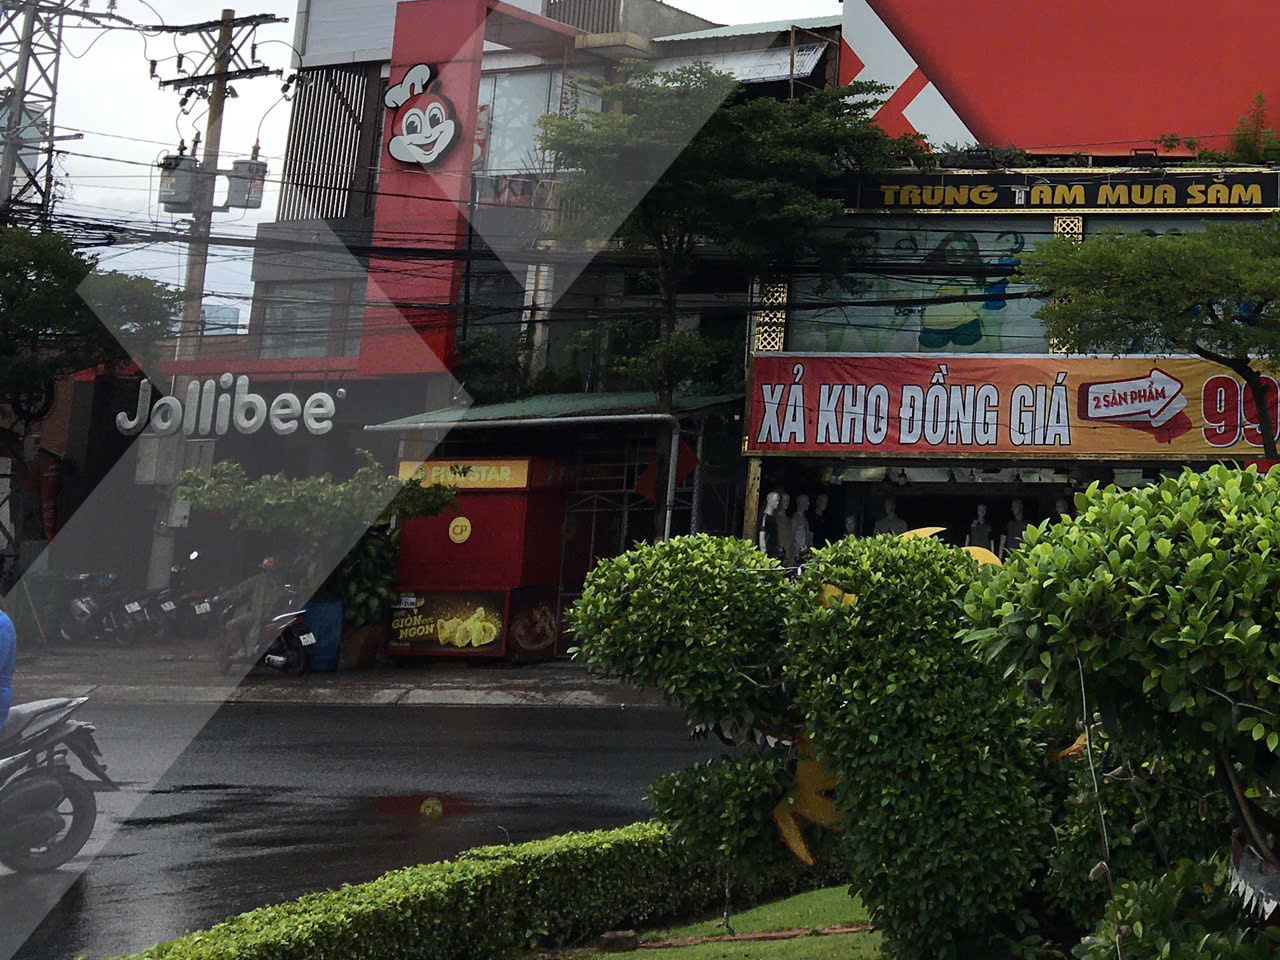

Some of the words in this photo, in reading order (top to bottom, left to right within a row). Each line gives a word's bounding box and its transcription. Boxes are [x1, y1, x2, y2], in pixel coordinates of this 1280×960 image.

[880, 184, 999, 206] TRUNG
[1010, 177, 1086, 206] TÂM
[1096, 184, 1177, 206] MUA
[115, 372, 336, 436] Jollibee
[757, 363, 806, 444] XẢ
[815, 383, 890, 445] KHO
[899, 363, 999, 445] ĐỒNG
[1008, 372, 1071, 445] GIÁ
[1093, 395, 1101, 409] 2
[1102, 388, 1129, 408] SẢN
[1130, 380, 1167, 405] PHẨM
[470, 465, 511, 482] STAR
[452, 524, 468, 535] CP
[399, 623, 435, 640] NGON
